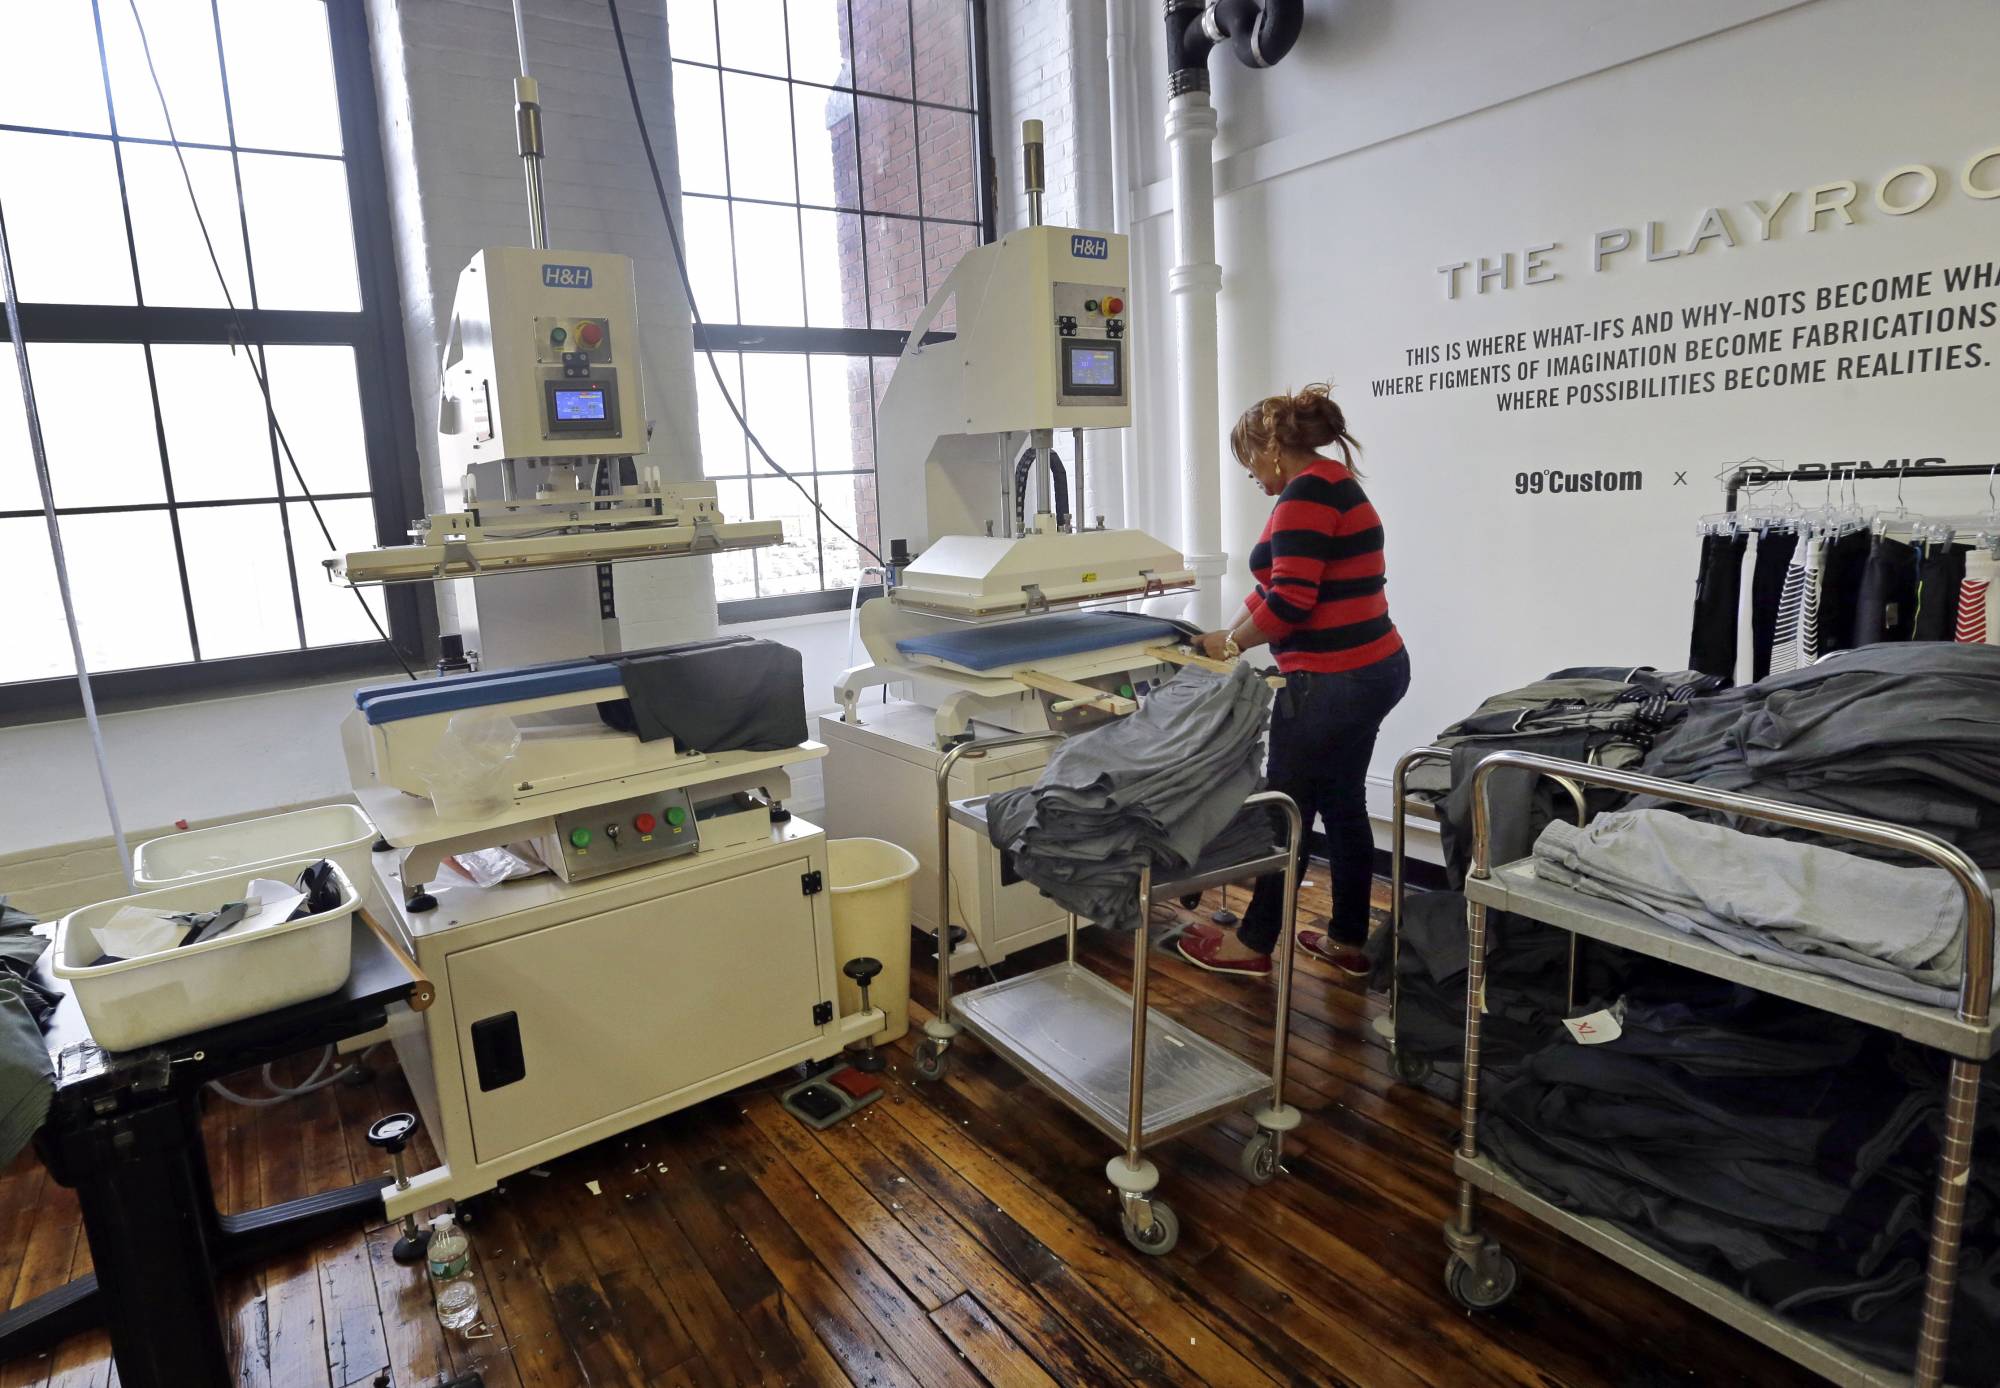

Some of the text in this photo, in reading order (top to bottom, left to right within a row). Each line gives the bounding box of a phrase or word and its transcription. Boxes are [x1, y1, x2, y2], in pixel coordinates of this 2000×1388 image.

[545, 267, 590, 287] H&H
[1073, 237, 1106, 257] H&H
[1437, 242, 1556, 299] THE
[1371, 301, 1998, 397] WHERE FIGMENTS OF IMAGINATION BECOME FABRICATIONS
[1406, 345, 1440, 367] THIS
[1446, 342, 1462, 361] IS
[1466, 332, 1527, 358] WHERE
[1532, 317, 1624, 349] WHAT-IFS
[1632, 311, 1673, 337] AND
[1681, 290, 1806, 330] WHY-NOTS
[1816, 271, 1933, 311] BECOME
[1496, 342, 1991, 412] WHERE POSSIBILITIES BECOME REALITIES.
